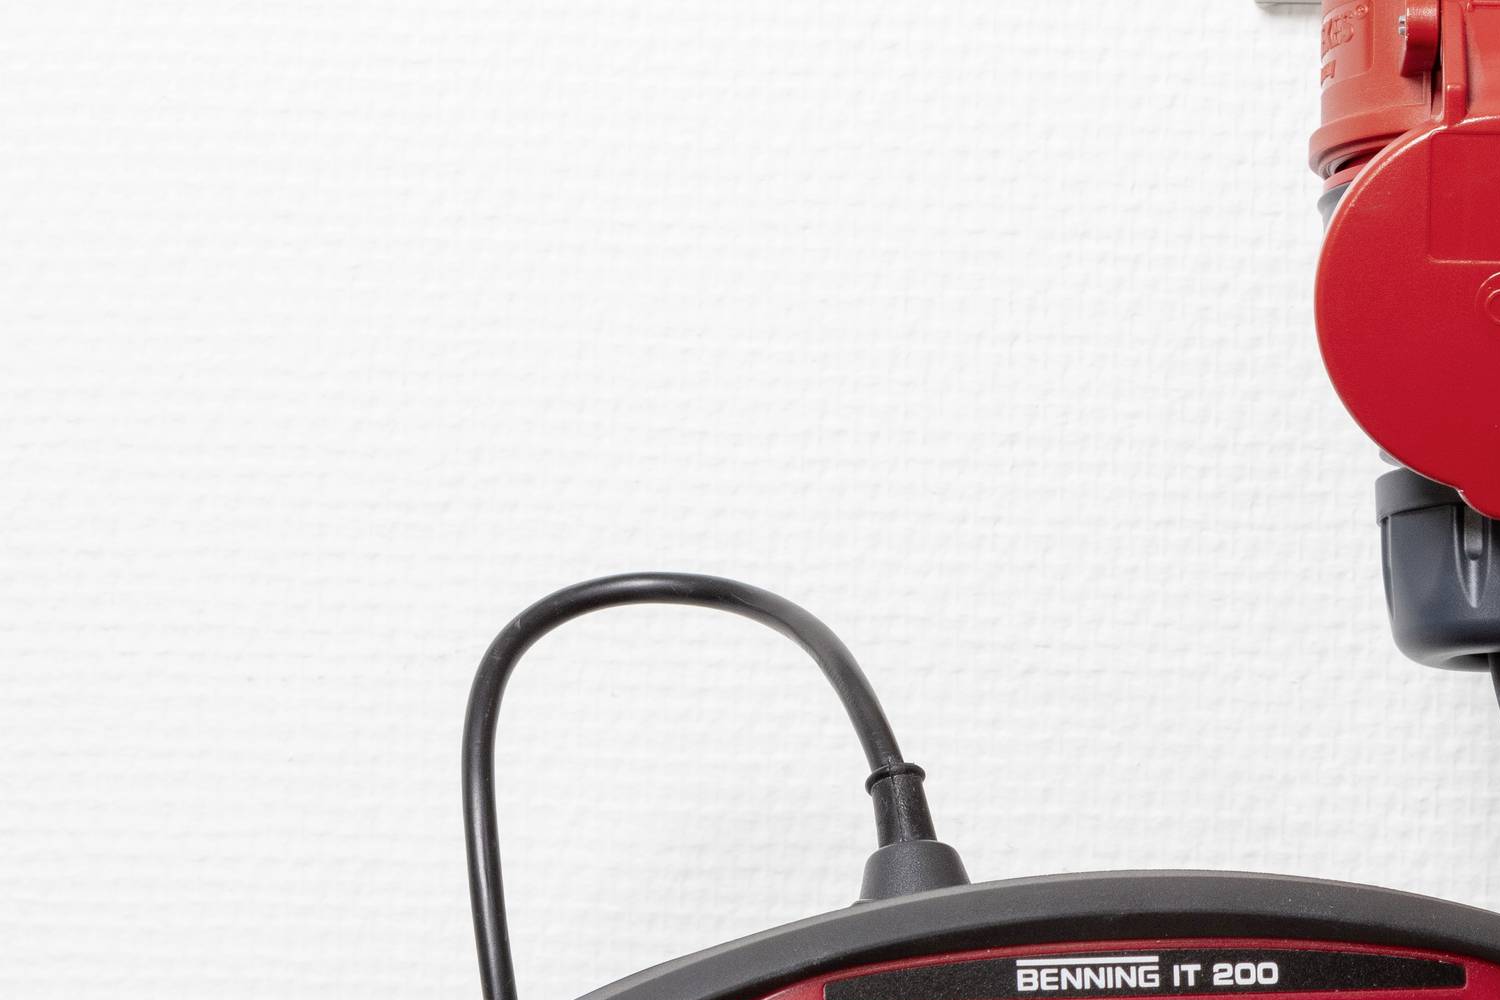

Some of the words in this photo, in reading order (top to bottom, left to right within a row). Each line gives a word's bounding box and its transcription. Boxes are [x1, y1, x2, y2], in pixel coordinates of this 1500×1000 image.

[1017, 966, 1159, 991] BENNING
[1173, 964, 1201, 986] IT
[1213, 962, 1278, 985] 200
